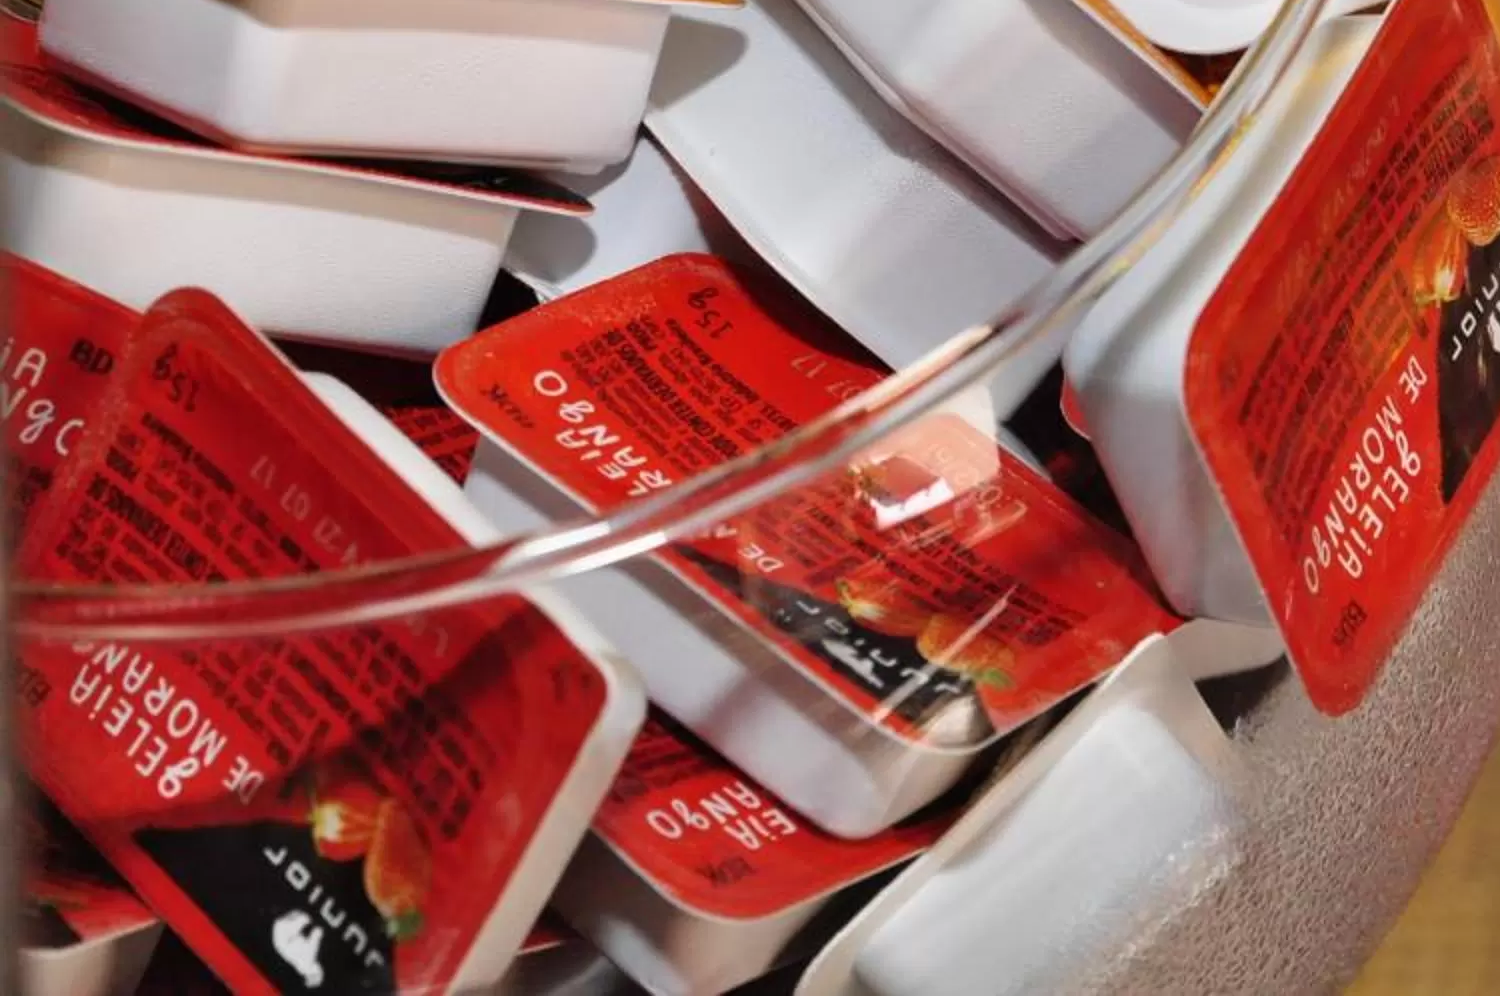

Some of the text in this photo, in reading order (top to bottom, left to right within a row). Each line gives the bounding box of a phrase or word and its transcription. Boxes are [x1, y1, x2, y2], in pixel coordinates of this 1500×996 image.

[1398, 354, 1429, 403] DE
[534, 370, 673, 490] RANgO
[555, 429, 650, 497] LEiA
[72, 640, 228, 768] MORAN
[222, 756, 265, 805] DE
